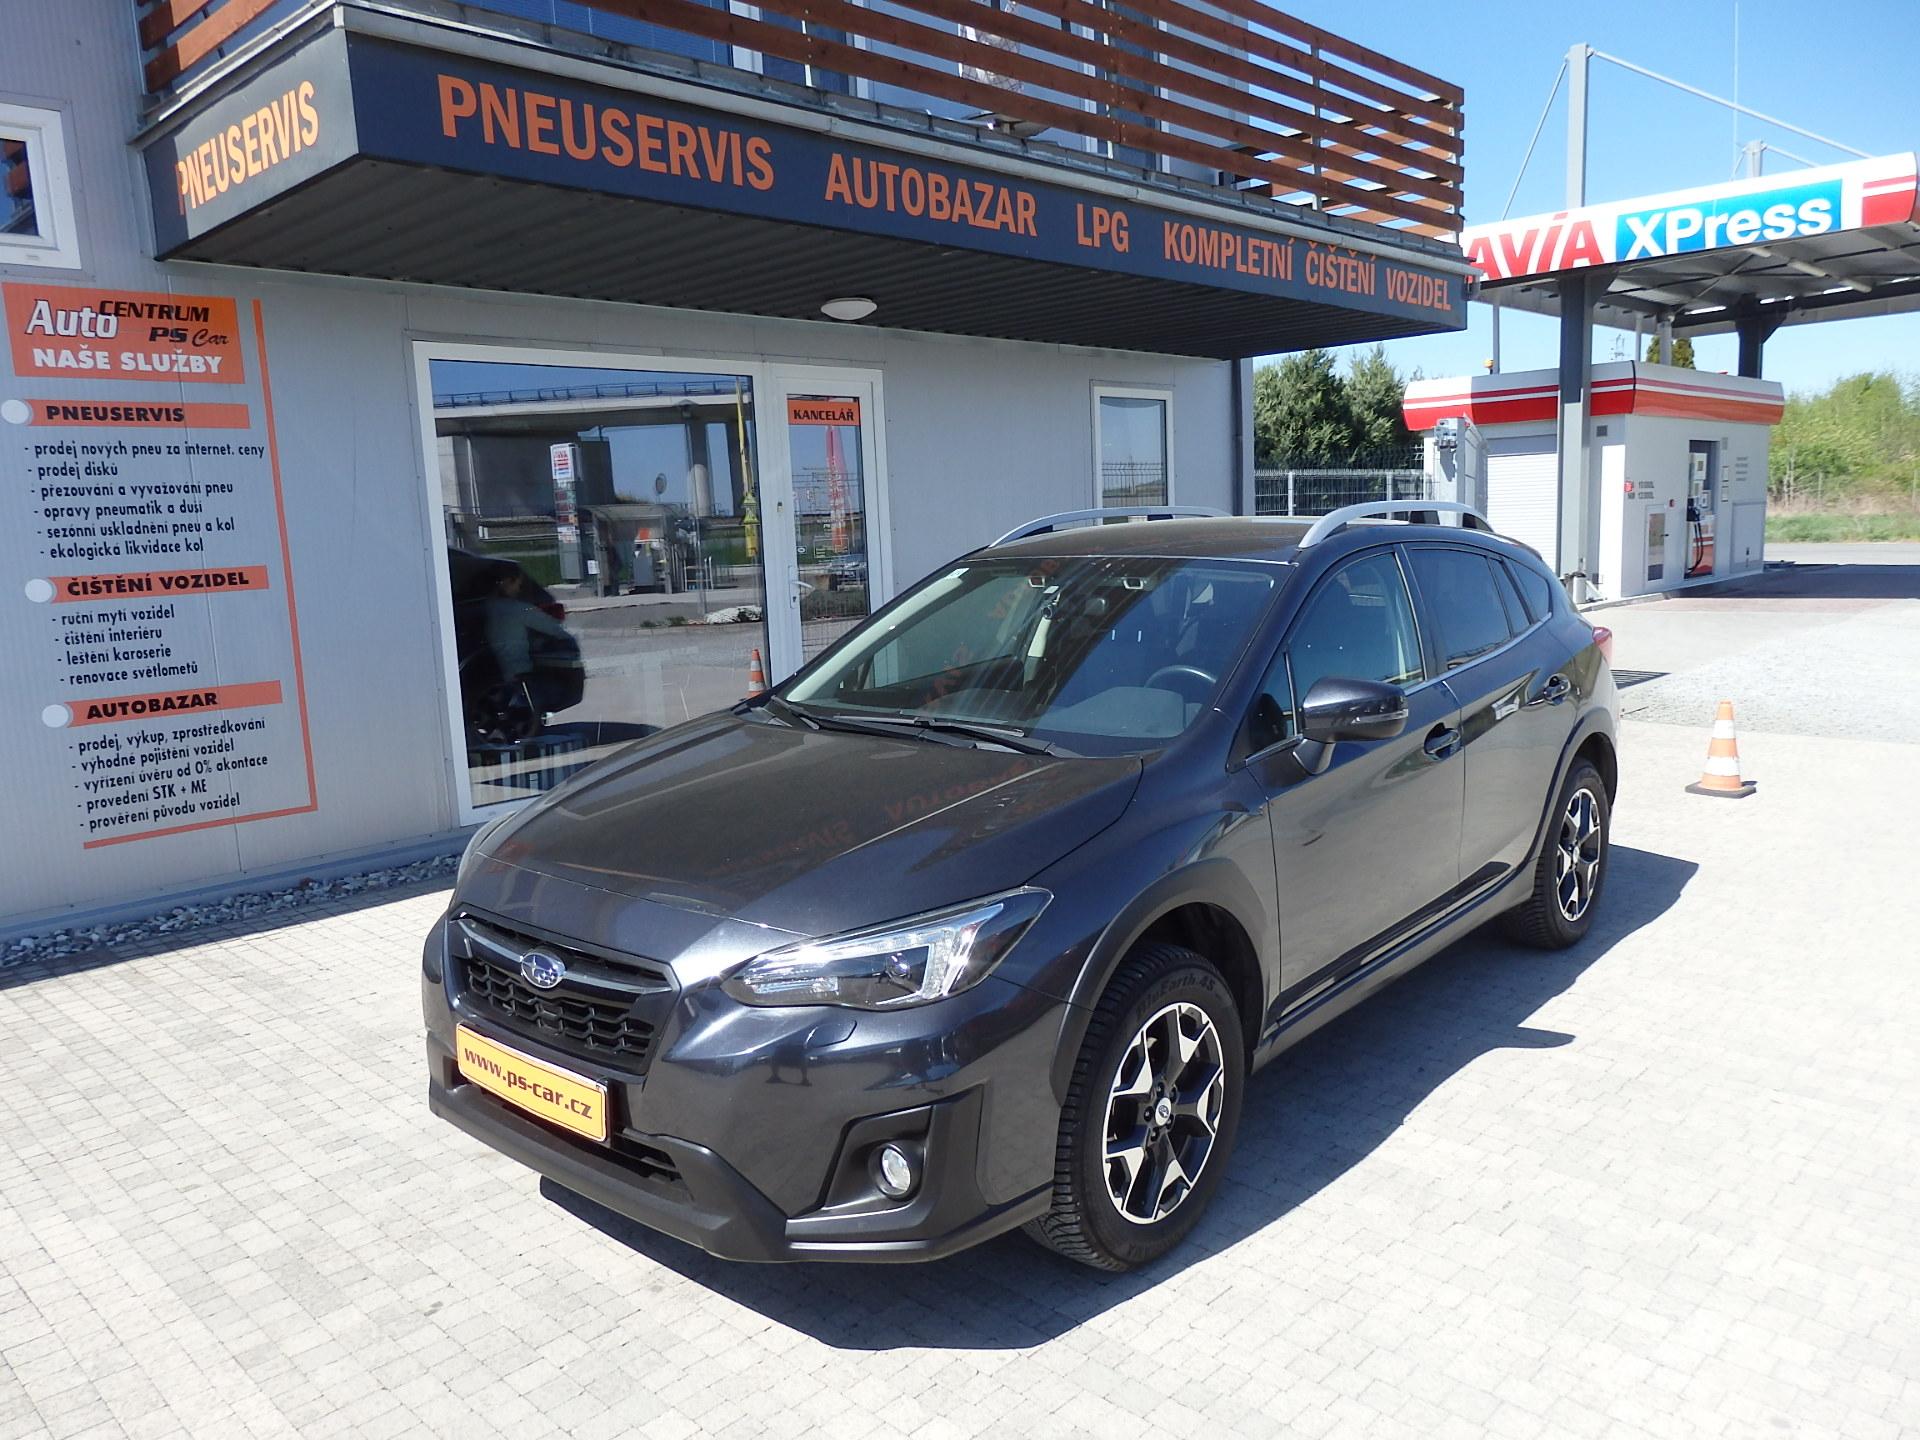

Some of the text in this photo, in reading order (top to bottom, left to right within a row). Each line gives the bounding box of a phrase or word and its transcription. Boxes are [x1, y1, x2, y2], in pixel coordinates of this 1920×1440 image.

[174, 80, 320, 215] PNEUSERVIS
[436, 73, 1452, 311] PNEUSERVIS AUTOBAZAR LPG KOMPLETNÍ ČIŠTĚNÍ VOZIDEL
[1624, 198, 1832, 260] XPress
[25, 299, 209, 339] Auto CENTRUM
[149, 326, 229, 347] PS Car
[32, 343, 222, 374] NAŠE SLUŽBY
[46, 405, 185, 422] PNEUSERVIS
[793, 408, 854, 421] KANCELÁŘ
[35, 440, 264, 459] prodej nových pneu za internet. ceny
[38, 461, 118, 480] prodej disků
[41, 483, 114, 501] přezouvání
[118, 486, 126, 496] a
[205, 483, 233, 497] pneu
[44, 506, 90, 521] opravy
[96, 500, 162, 520] pneumatik
[167, 504, 175, 514] a
[172, 522, 201, 537] pneu
[206, 522, 212, 532] a
[216, 516, 234, 531] kol
[50, 537, 203, 560] ekologická likvidace kol
[67, 572, 249, 596] ČIŠTĚNÍ VOZIDEL
[61, 610, 93, 625] ruční
[131, 604, 174, 620] vozidel
[113, 644, 171, 661] karoserie
[69, 671, 128, 685] renovace
[87, 692, 218, 719] AUTOBAZAR
[79, 734, 122, 756] prodej,
[194, 737, 234, 756] vozidel
[177, 762, 190, 777] od
[195, 760, 212, 774] 0%
[217, 756, 268, 772] akontace
[87, 789, 149, 814] provedení
[153, 784, 176, 800] STK
[192, 779, 207, 794] ME
[153, 800, 195, 822] původu
[200, 792, 240, 811] vozidel
[465, 1048, 592, 1120] www.ps-car.cz
